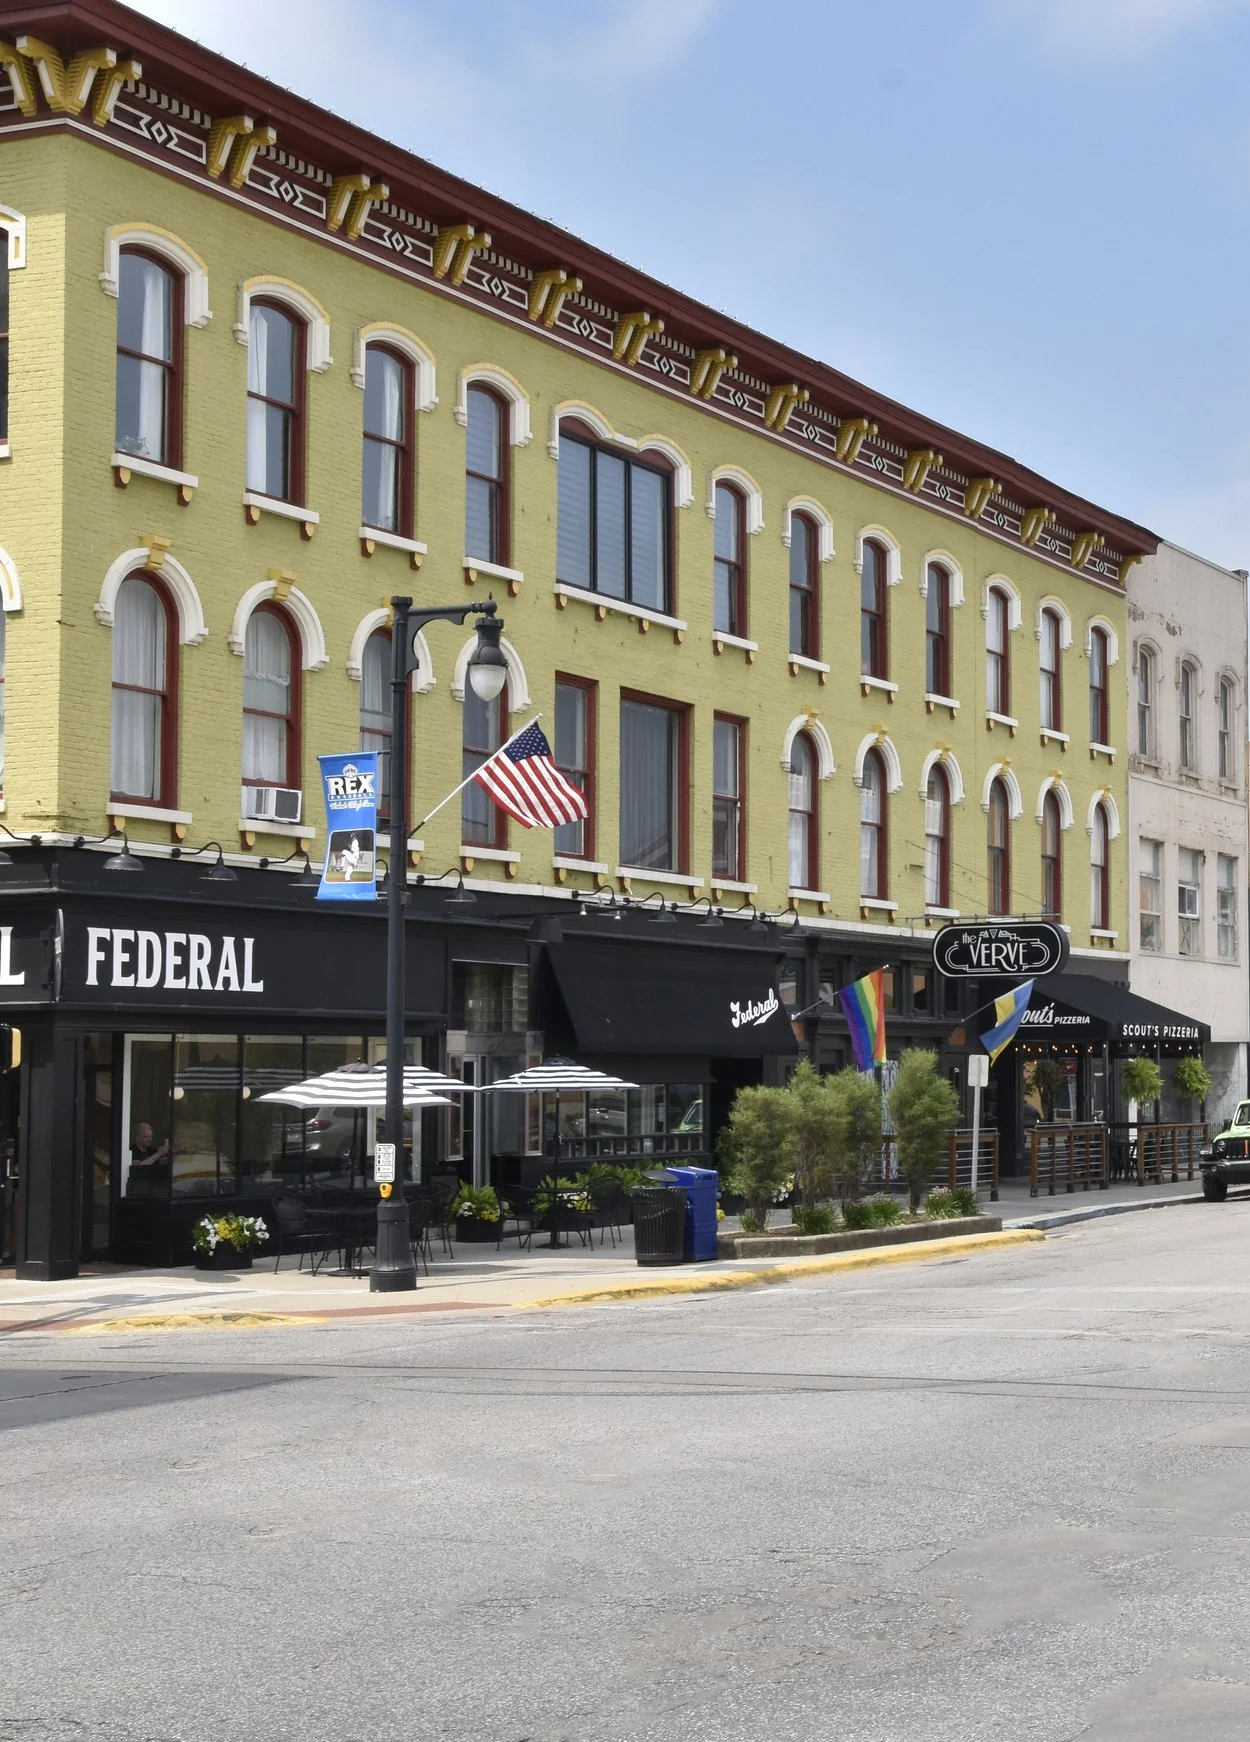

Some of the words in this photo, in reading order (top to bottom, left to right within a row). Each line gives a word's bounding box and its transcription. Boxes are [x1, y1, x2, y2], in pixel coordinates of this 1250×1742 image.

[327, 774, 375, 796] REX
[962, 932, 977, 944] the
[85, 926, 264, 992] FEDERAL
[970, 937, 1028, 971] VERVE
[730, 988, 779, 1028] Federal
[1019, 1002, 1055, 1024] out's
[1054, 1015, 1090, 1024] PIZZERIA
[1123, 1024, 1159, 1037] SCOUT'S
[1163, 1026, 1199, 1039] PIZZERIA
